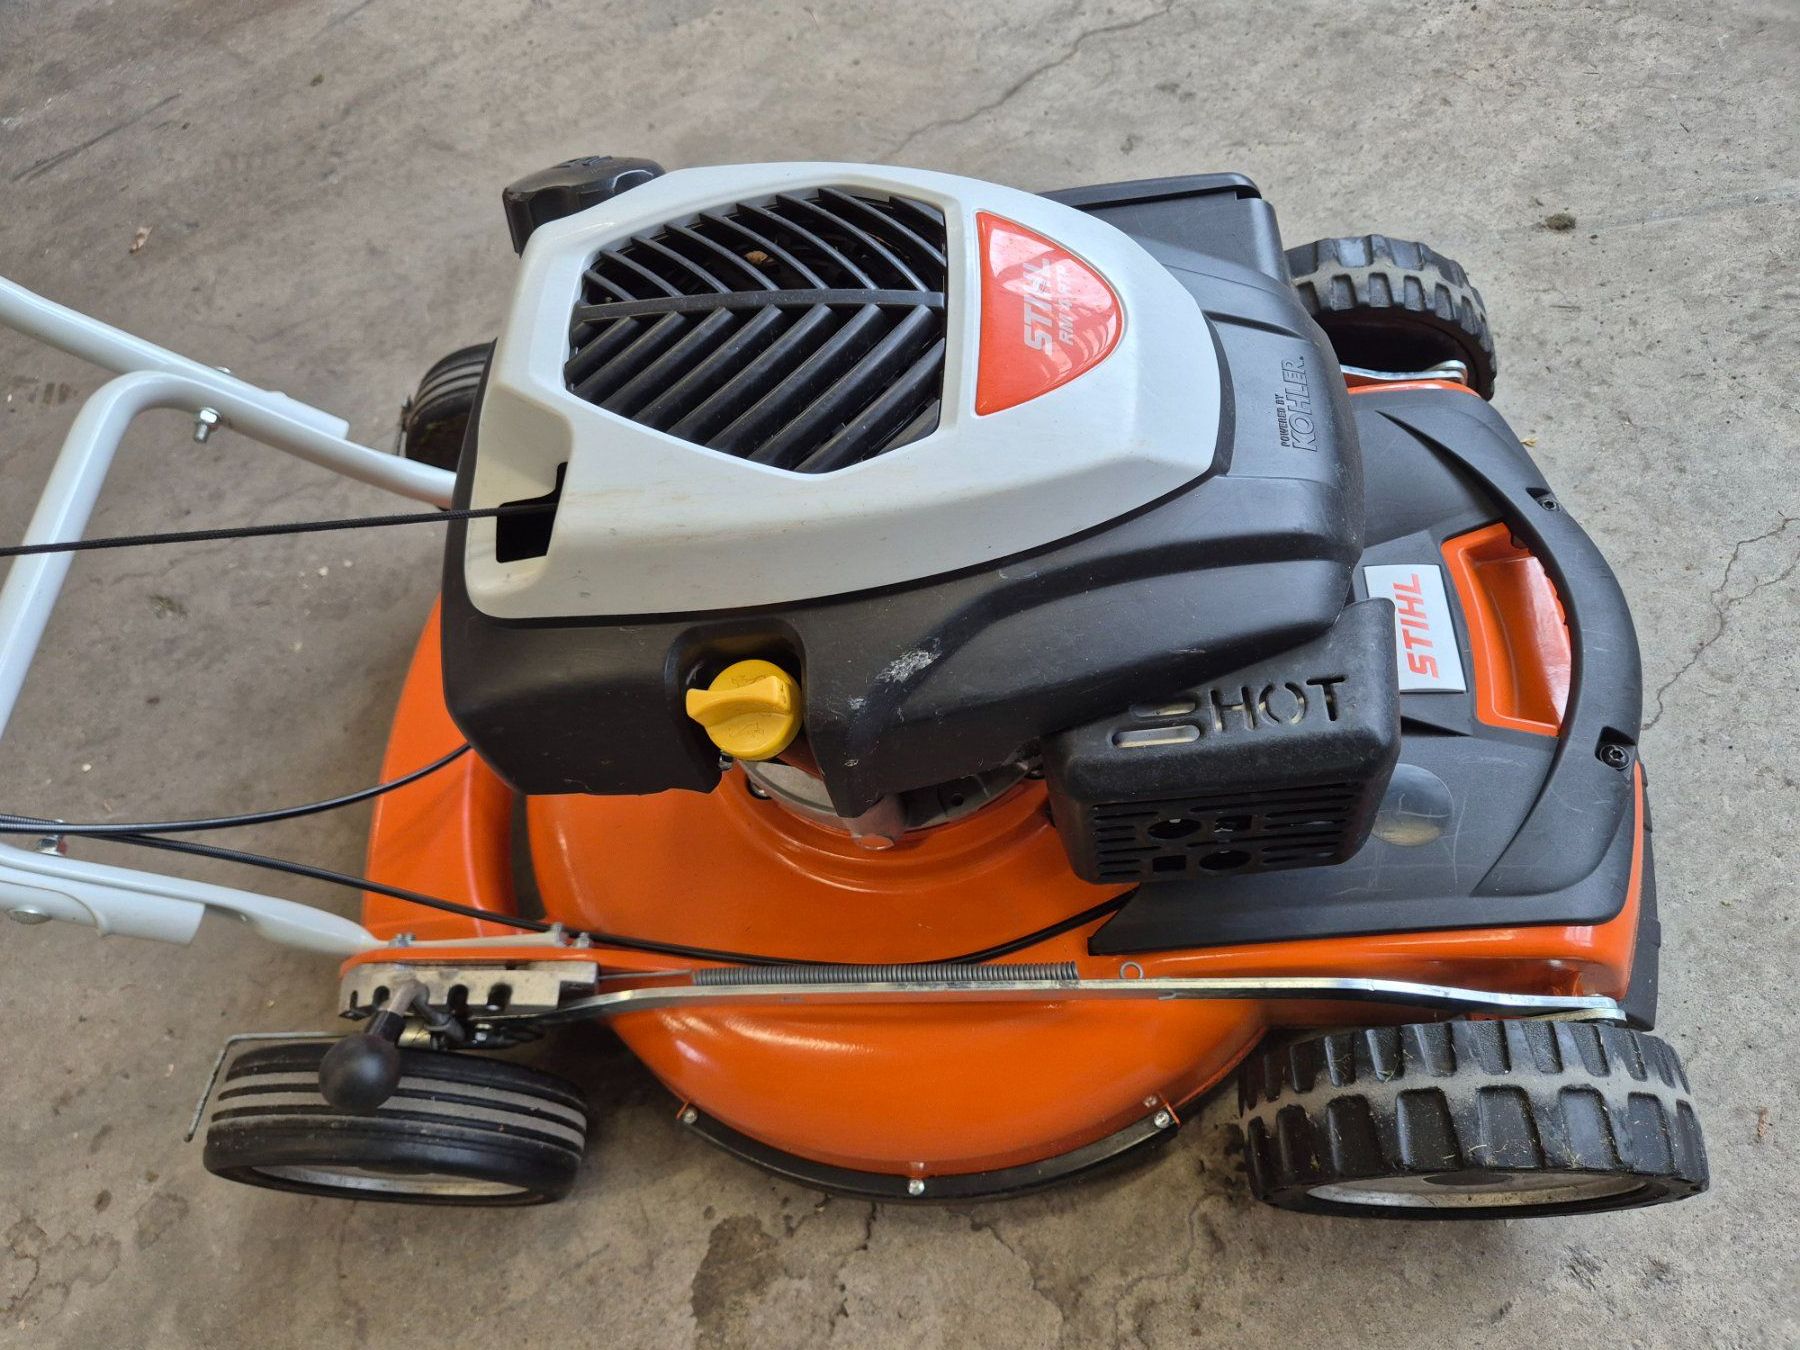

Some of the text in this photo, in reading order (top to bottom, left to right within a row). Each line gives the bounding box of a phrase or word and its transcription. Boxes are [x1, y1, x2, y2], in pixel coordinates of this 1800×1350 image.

[1023, 258, 1053, 357] STIHL
[1058, 312, 1074, 346] RM
[1275, 393, 1291, 447] POWERED BY
[1393, 573, 1440, 680] STIHL
[1209, 674, 1350, 733] HOT
